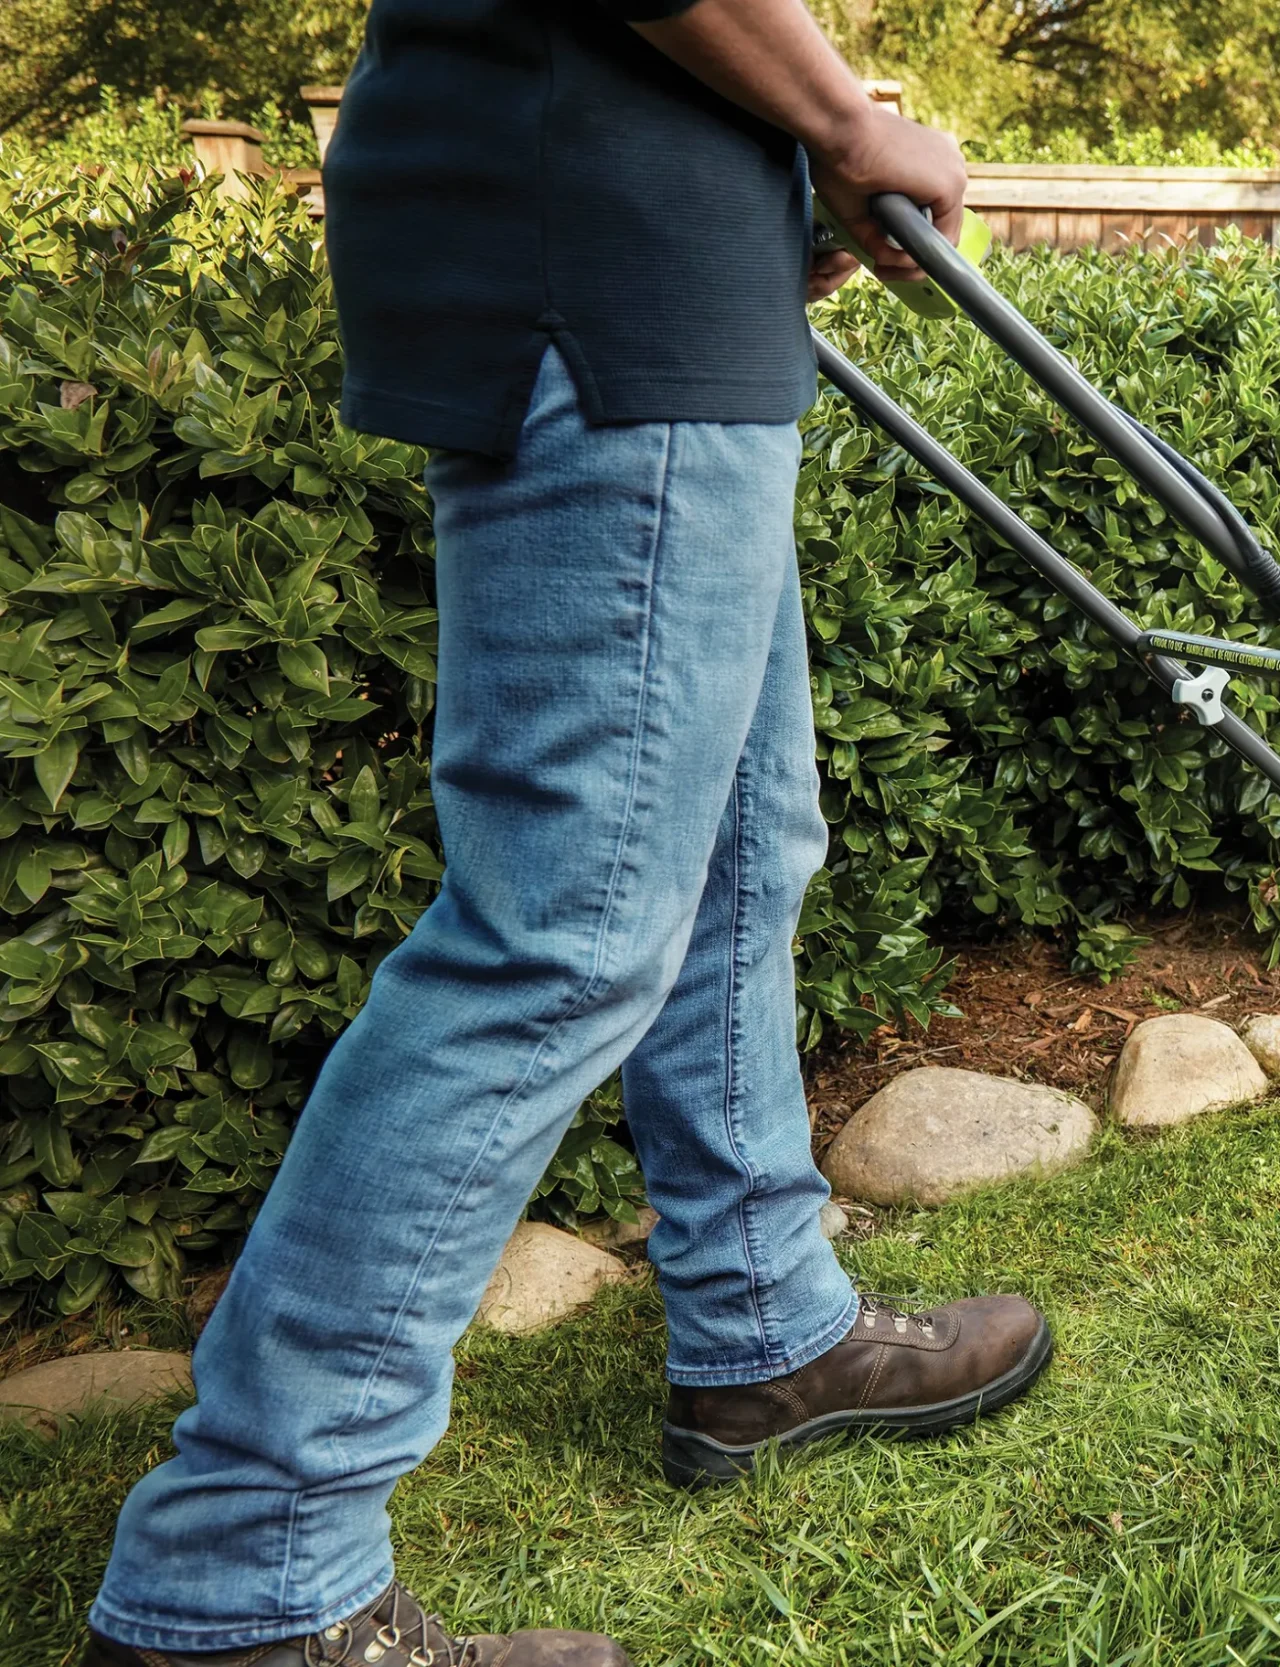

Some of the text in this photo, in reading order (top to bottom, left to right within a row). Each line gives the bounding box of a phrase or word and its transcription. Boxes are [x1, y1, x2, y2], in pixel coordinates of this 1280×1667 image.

[1154, 636, 1167, 649] PRIOR
[1168, 639, 1174, 650] TO
[1174, 641, 1184, 652] USE
[1186, 643, 1204, 656] HANDLE
[1204, 646, 1218, 659] MUST
[1218, 649, 1225, 660] BE
[1224, 650, 1239, 663] FULLY
[1238, 653, 1264, 668] EXTENDED
[1264, 657, 1277, 670] AND
